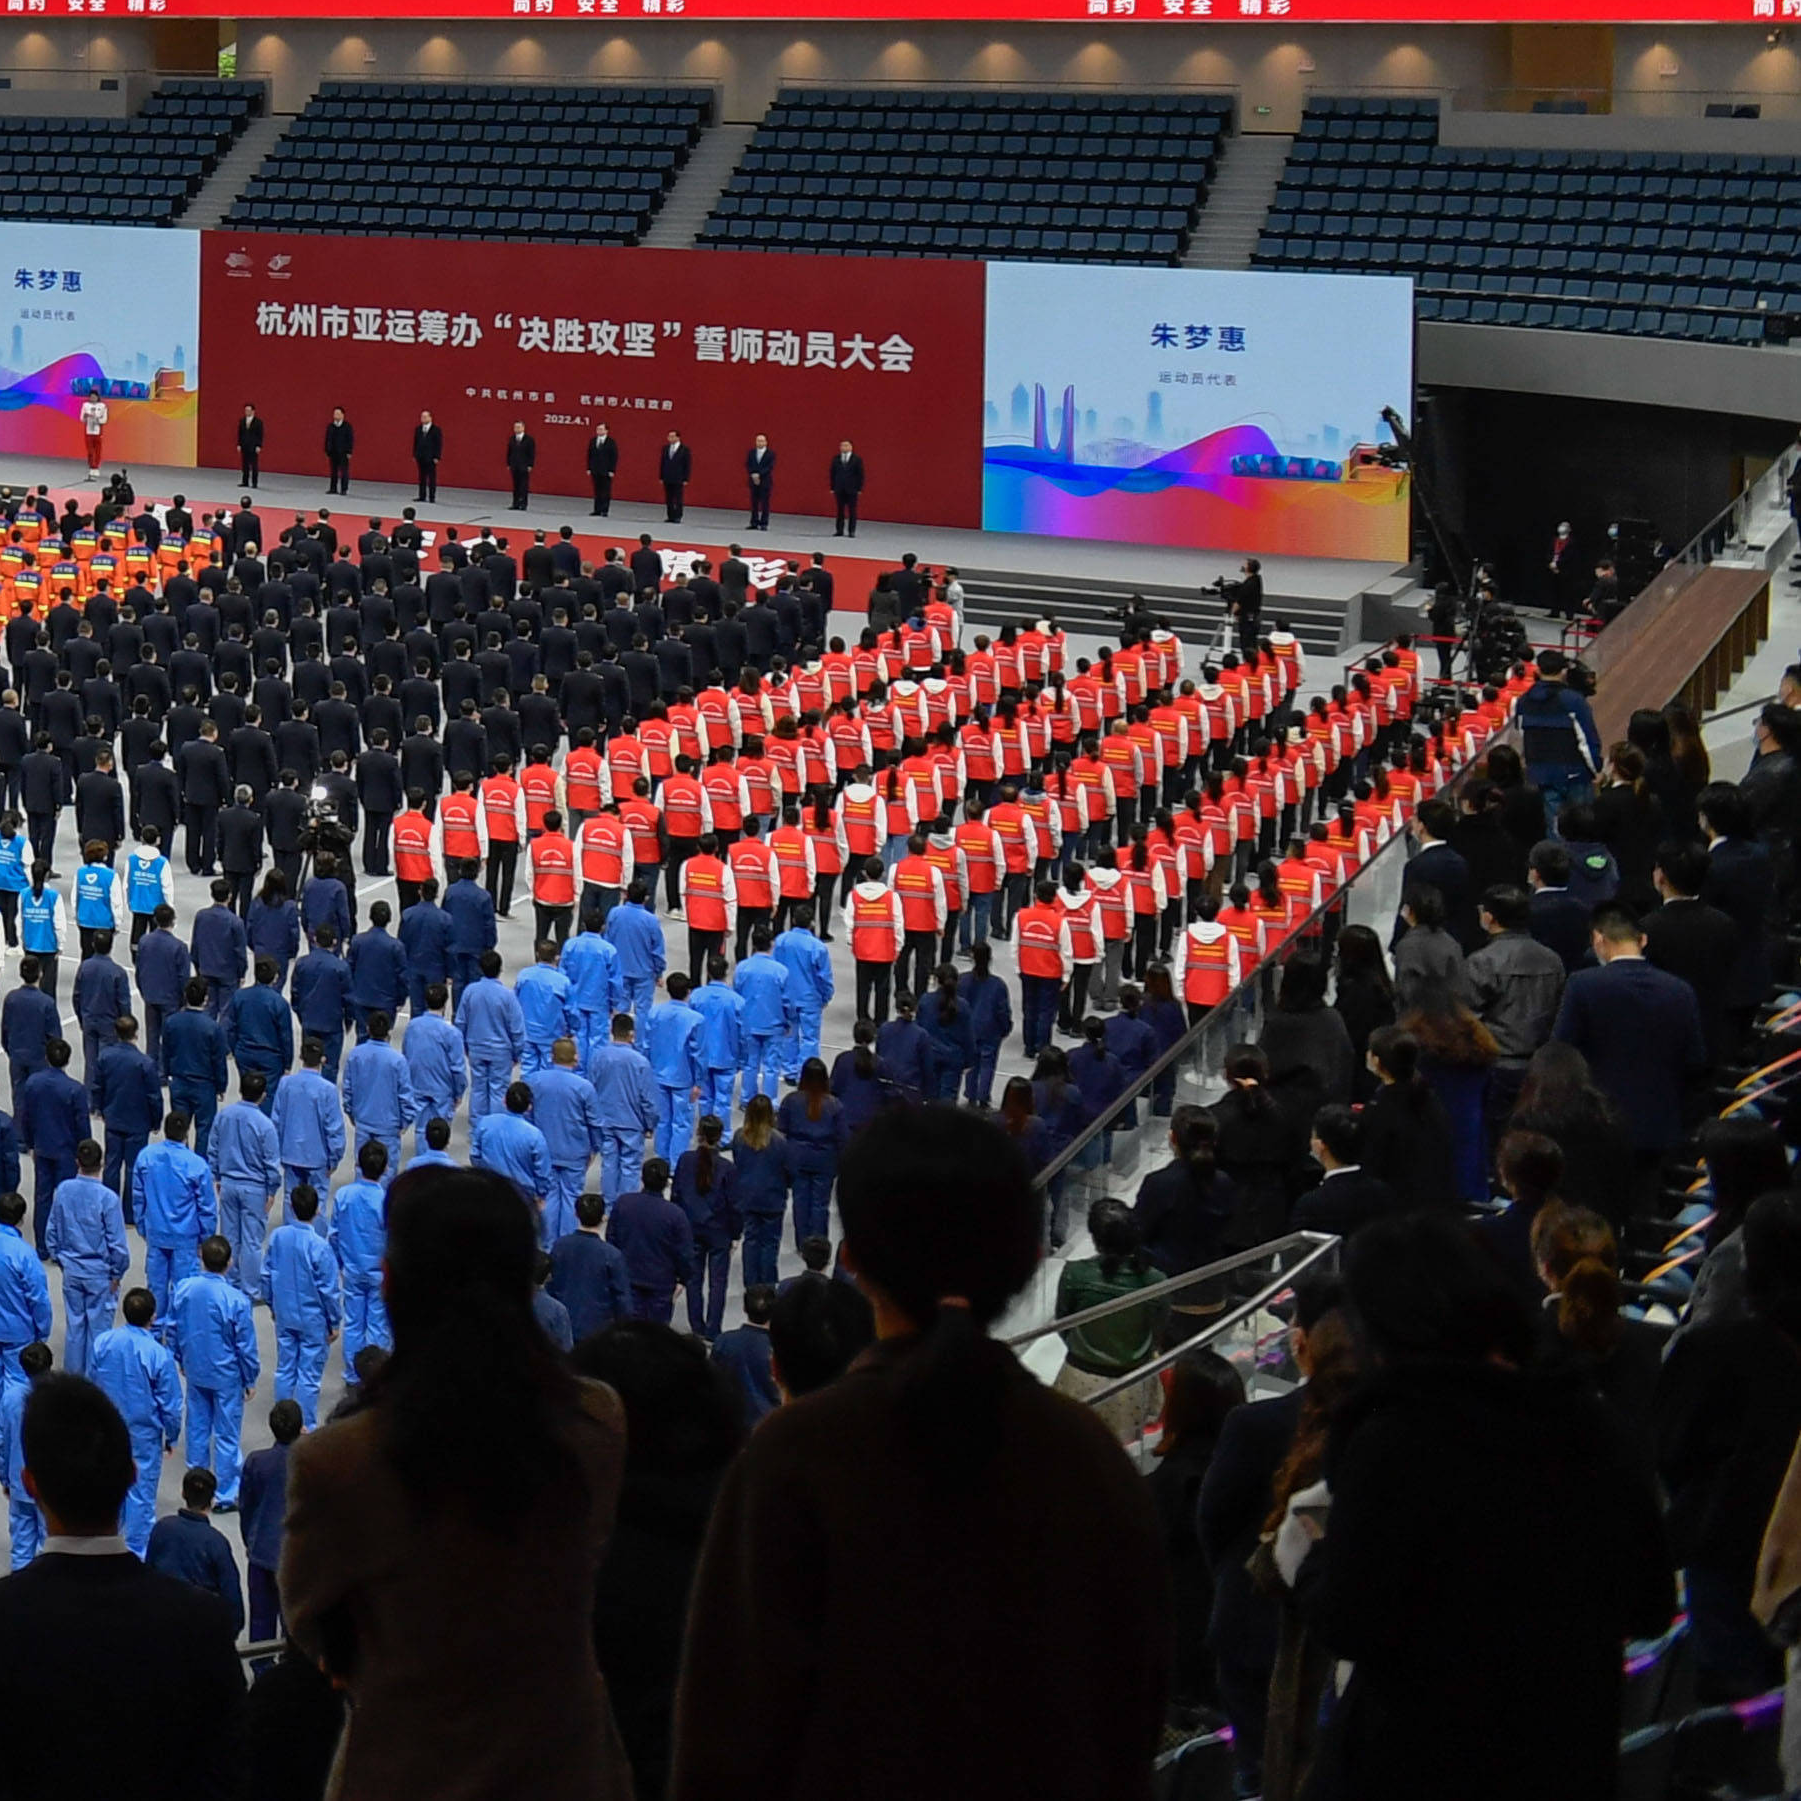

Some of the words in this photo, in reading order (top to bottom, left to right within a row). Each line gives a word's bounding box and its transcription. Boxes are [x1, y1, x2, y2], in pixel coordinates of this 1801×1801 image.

[14, 267, 83, 293] 朱梦惠
[255, 301, 914, 373] 杭州市亚运筹办“决胜攻坚”誓师动员大会
[1150, 322, 1247, 352] 朱梦惠
[1157, 370, 1238, 386] 运动员代表
[544, 413, 591, 427] 2022.4.1
